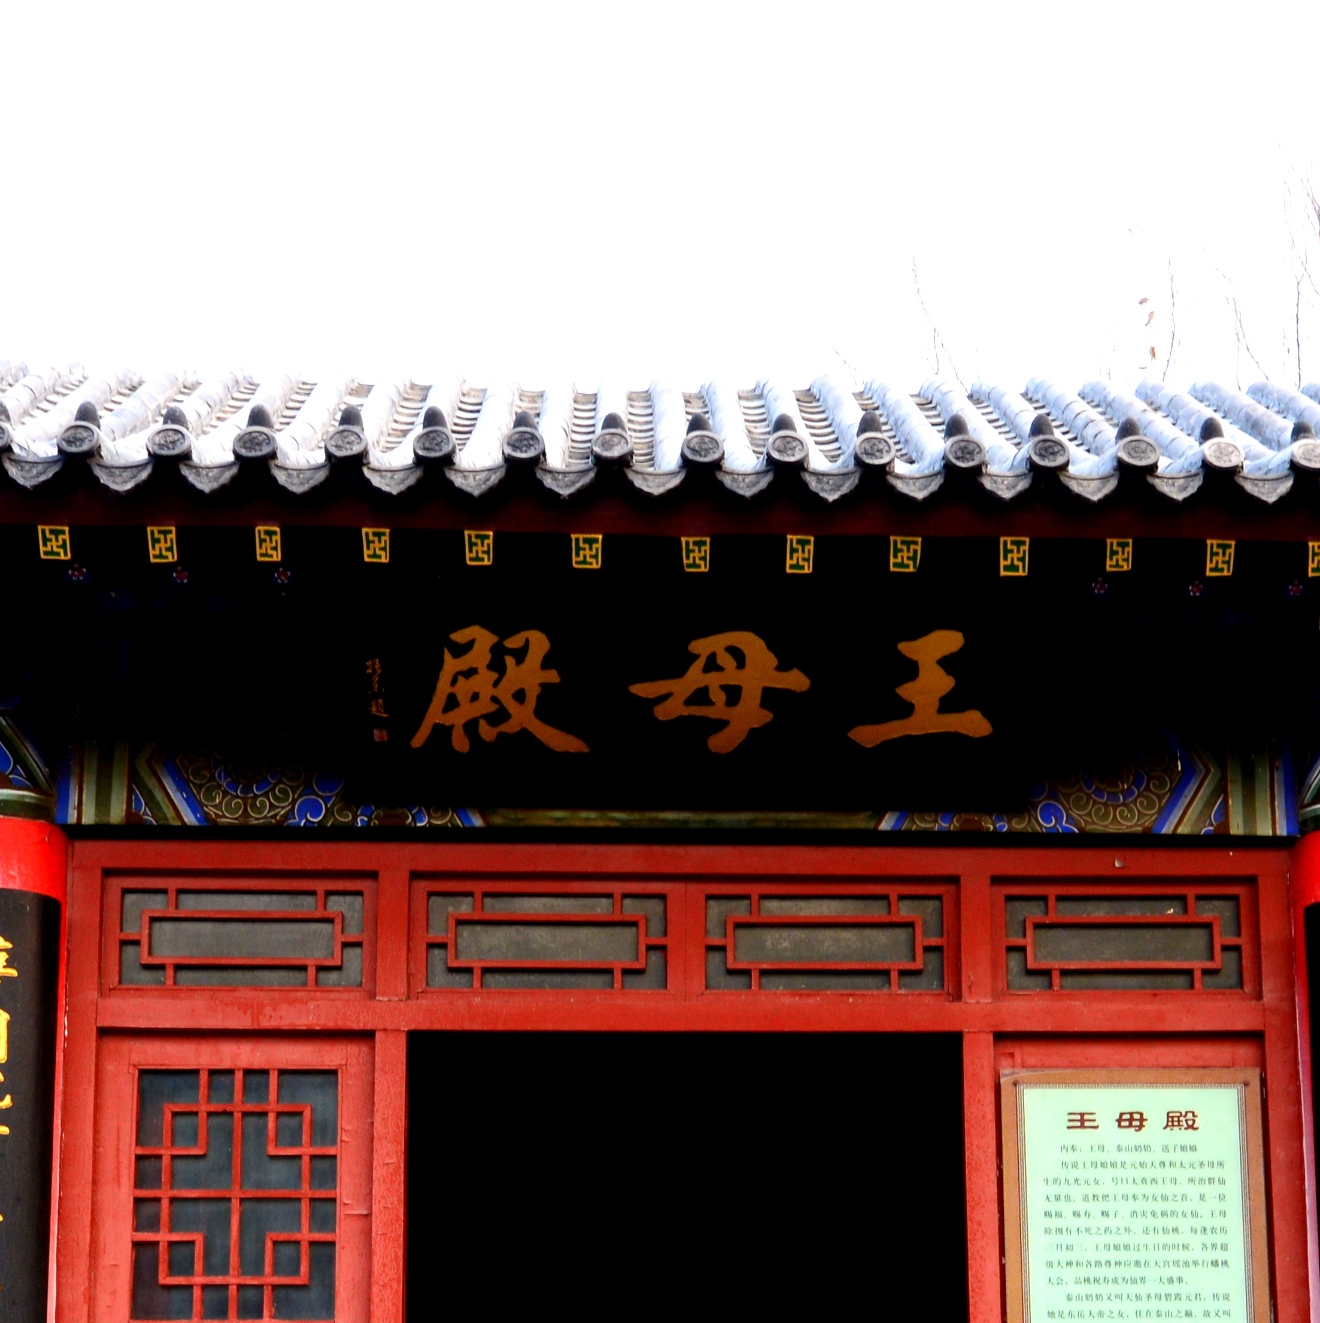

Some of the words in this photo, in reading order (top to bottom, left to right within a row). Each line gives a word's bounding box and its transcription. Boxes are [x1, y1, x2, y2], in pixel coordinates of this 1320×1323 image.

[410, 624, 994, 754] 王母殿
[1066, 1110, 1200, 1132] 王母殿
